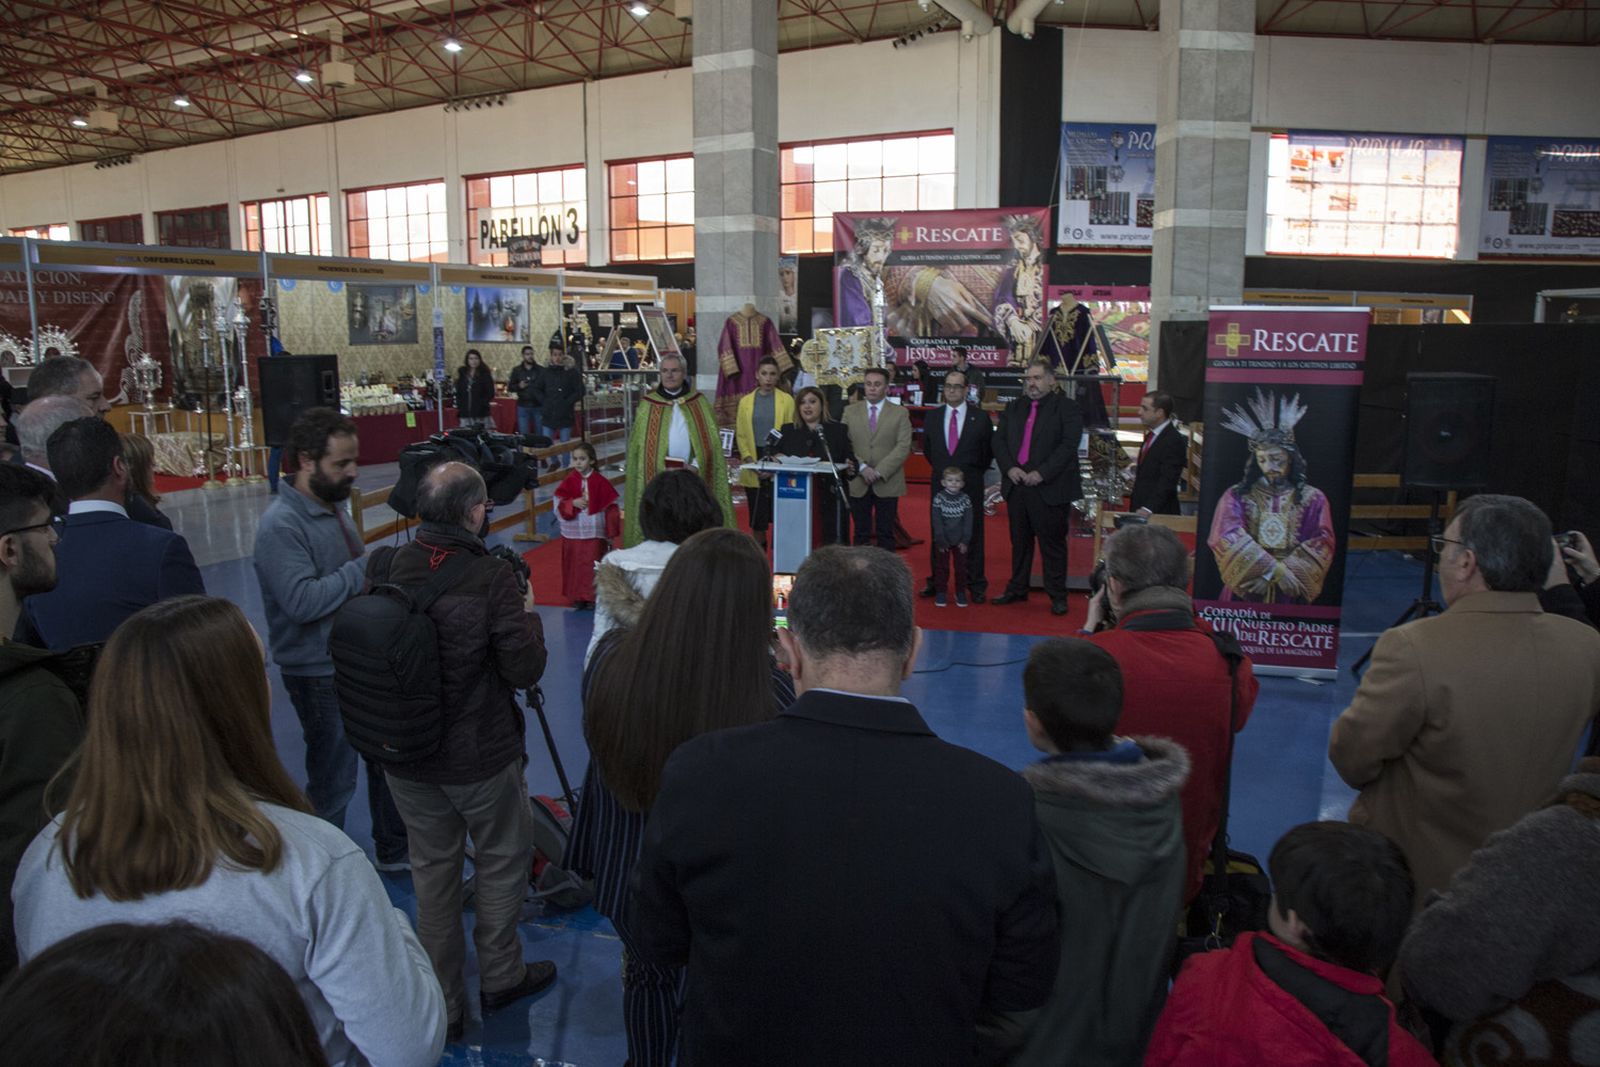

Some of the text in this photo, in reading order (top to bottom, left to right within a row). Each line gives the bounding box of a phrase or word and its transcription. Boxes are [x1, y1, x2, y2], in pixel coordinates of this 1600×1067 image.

[566, 208, 579, 244] 3
[916, 226, 1002, 243] RESCATE
[53, 288, 116, 305] DISEÑO
[1252, 328, 1359, 353] RESCATE
[1204, 605, 1272, 620] COFRADÍA DE
[1241, 618, 1334, 634] NUESTRO PADRE
[1240, 630, 1257, 642] DEL
[1257, 629, 1334, 650] RESCATE
